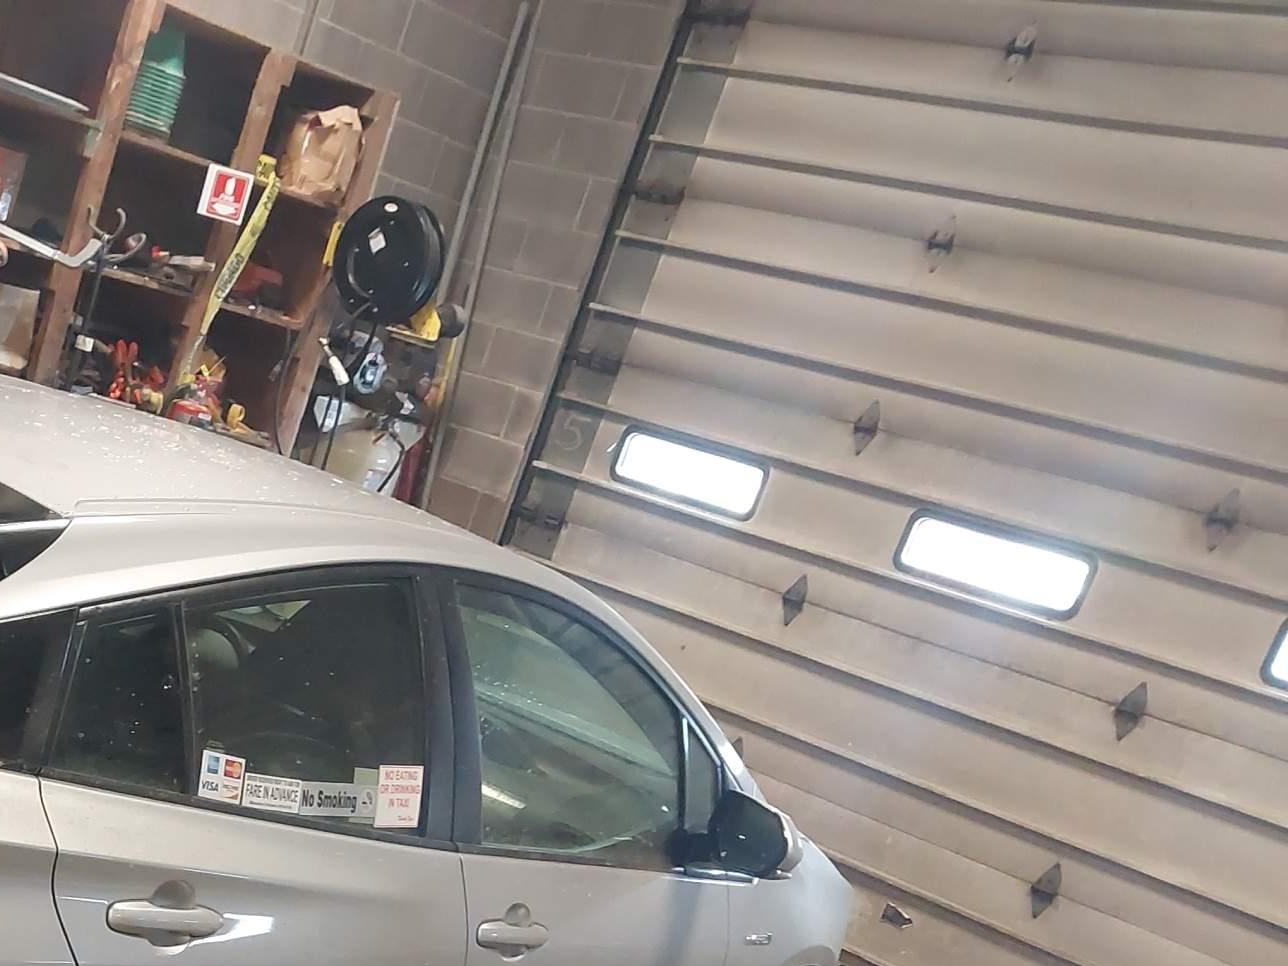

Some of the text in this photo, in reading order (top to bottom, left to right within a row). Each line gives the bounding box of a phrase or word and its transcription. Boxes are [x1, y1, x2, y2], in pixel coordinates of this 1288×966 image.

[396, 770, 418, 781] EATING
[202, 780, 220, 793] VISA
[246, 783, 263, 799] FARE
[270, 785, 299, 804] ADVANCE
[301, 789, 357, 813] No Smoking
